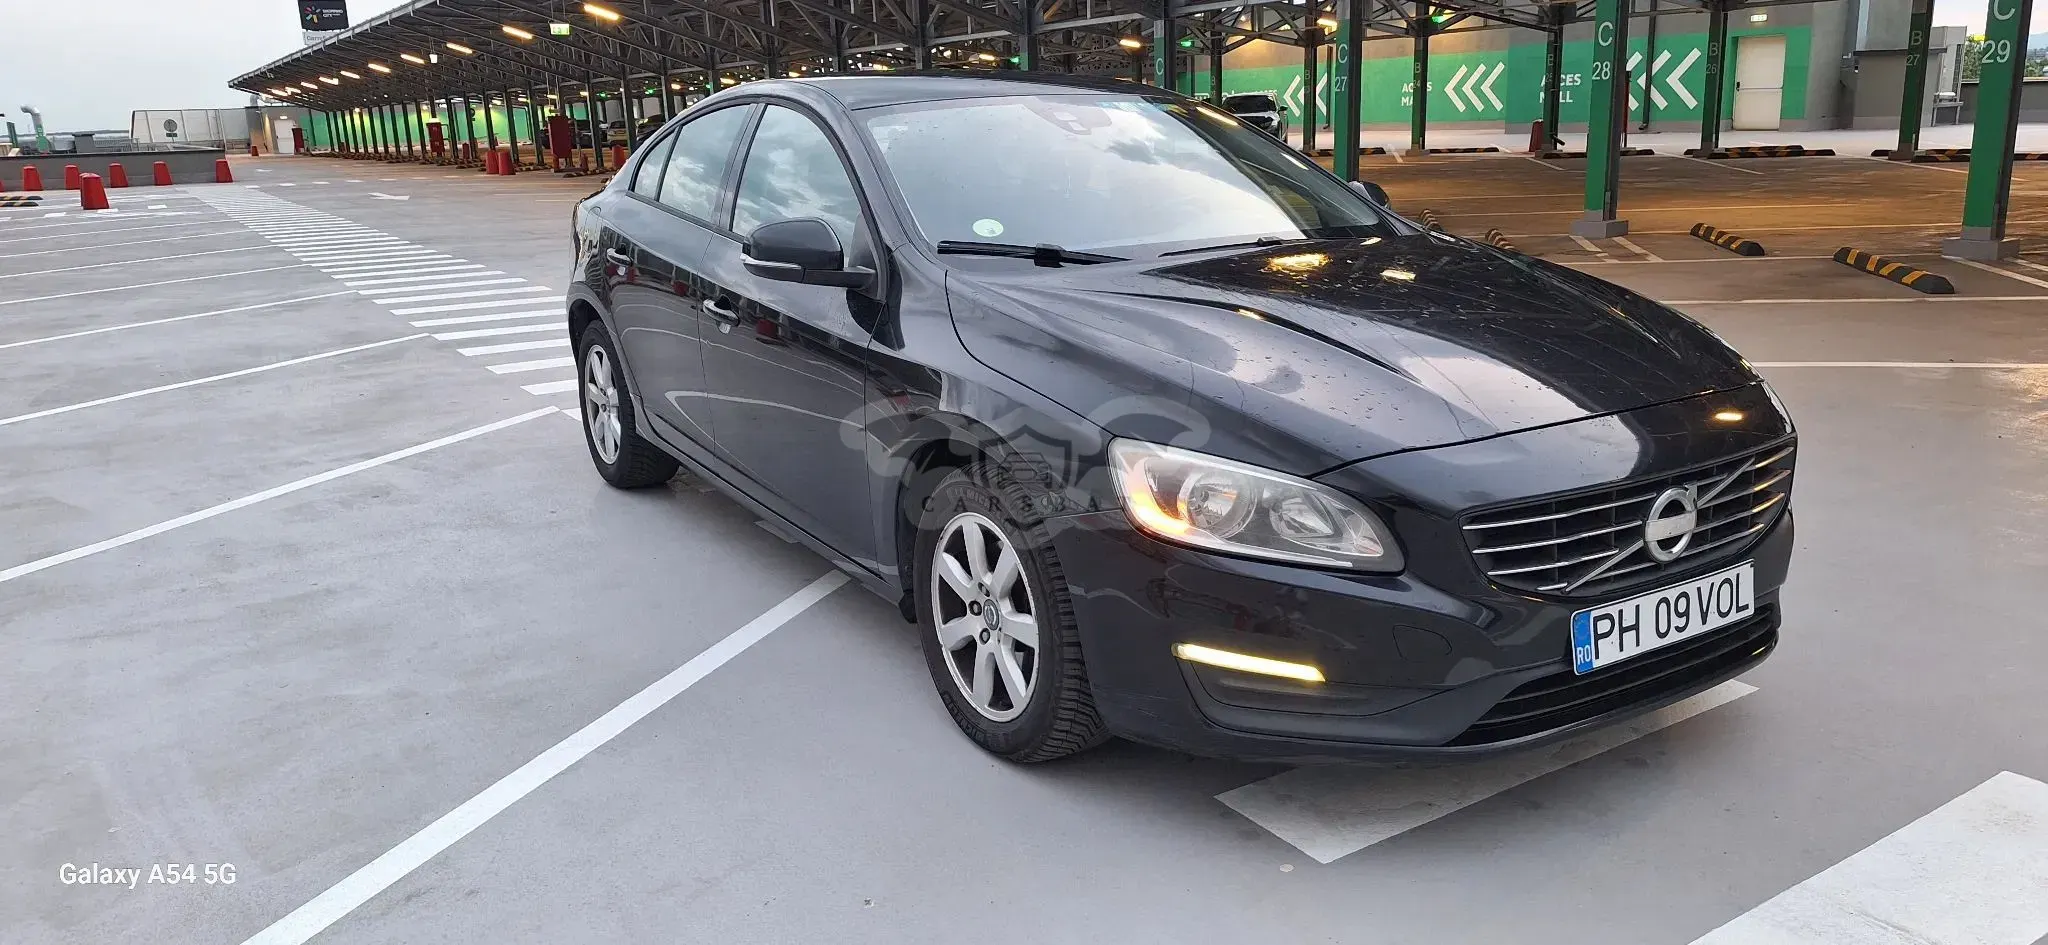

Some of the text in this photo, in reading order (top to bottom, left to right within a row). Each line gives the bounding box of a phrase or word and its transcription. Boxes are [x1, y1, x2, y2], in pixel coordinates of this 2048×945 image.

[1598, 21, 1614, 47] C
[1911, 30, 1923, 46] B
[1337, 43, 1348, 63] C
[1710, 42, 1719, 56] B
[1981, 39, 2011, 64] 29
[1414, 62, 1421, 74] B
[1705, 63, 1717, 74] 26
[1906, 54, 1920, 66] 27
[1591, 61, 1611, 80] 28
[1335, 76, 1348, 92] 27
[1592, 572, 1750, 660] PH 09 VOL
[1576, 644, 1591, 665] RO
